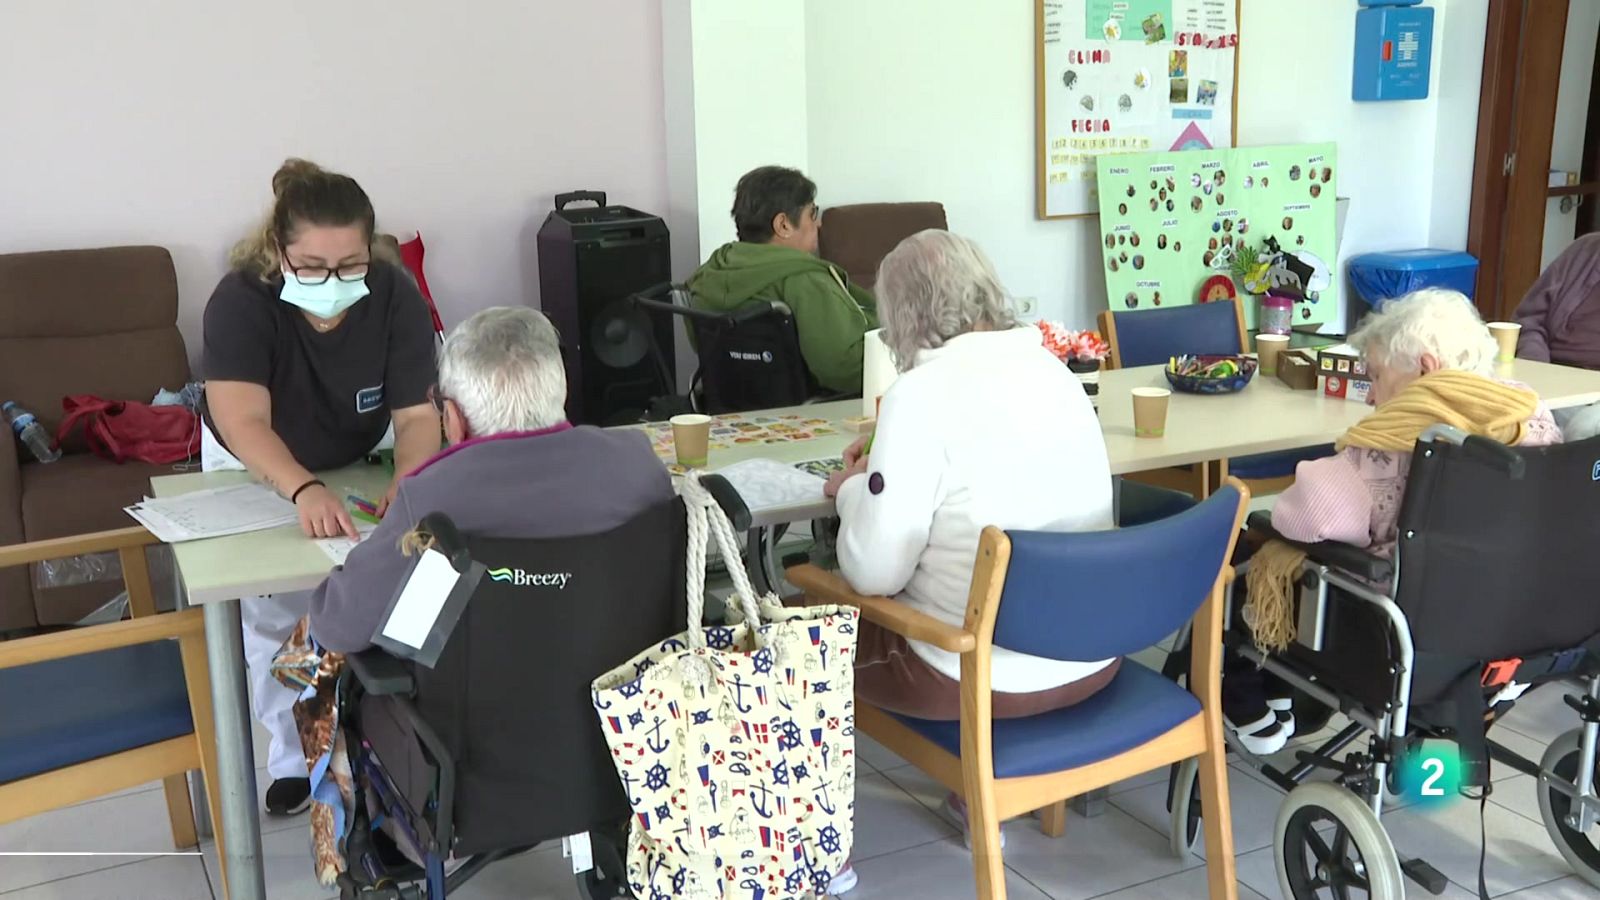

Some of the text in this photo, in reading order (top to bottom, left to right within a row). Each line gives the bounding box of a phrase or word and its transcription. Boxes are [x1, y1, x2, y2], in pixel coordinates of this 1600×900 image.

[1068, 49, 1111, 64] CLIMA
[1308, 156, 1324, 164] MAYO
[1149, 165, 1175, 173] FEBRERO
[1201, 161, 1221, 169] MARZO
[1162, 219, 1178, 227] JULIO
[514, 568, 569, 589] Breezy
